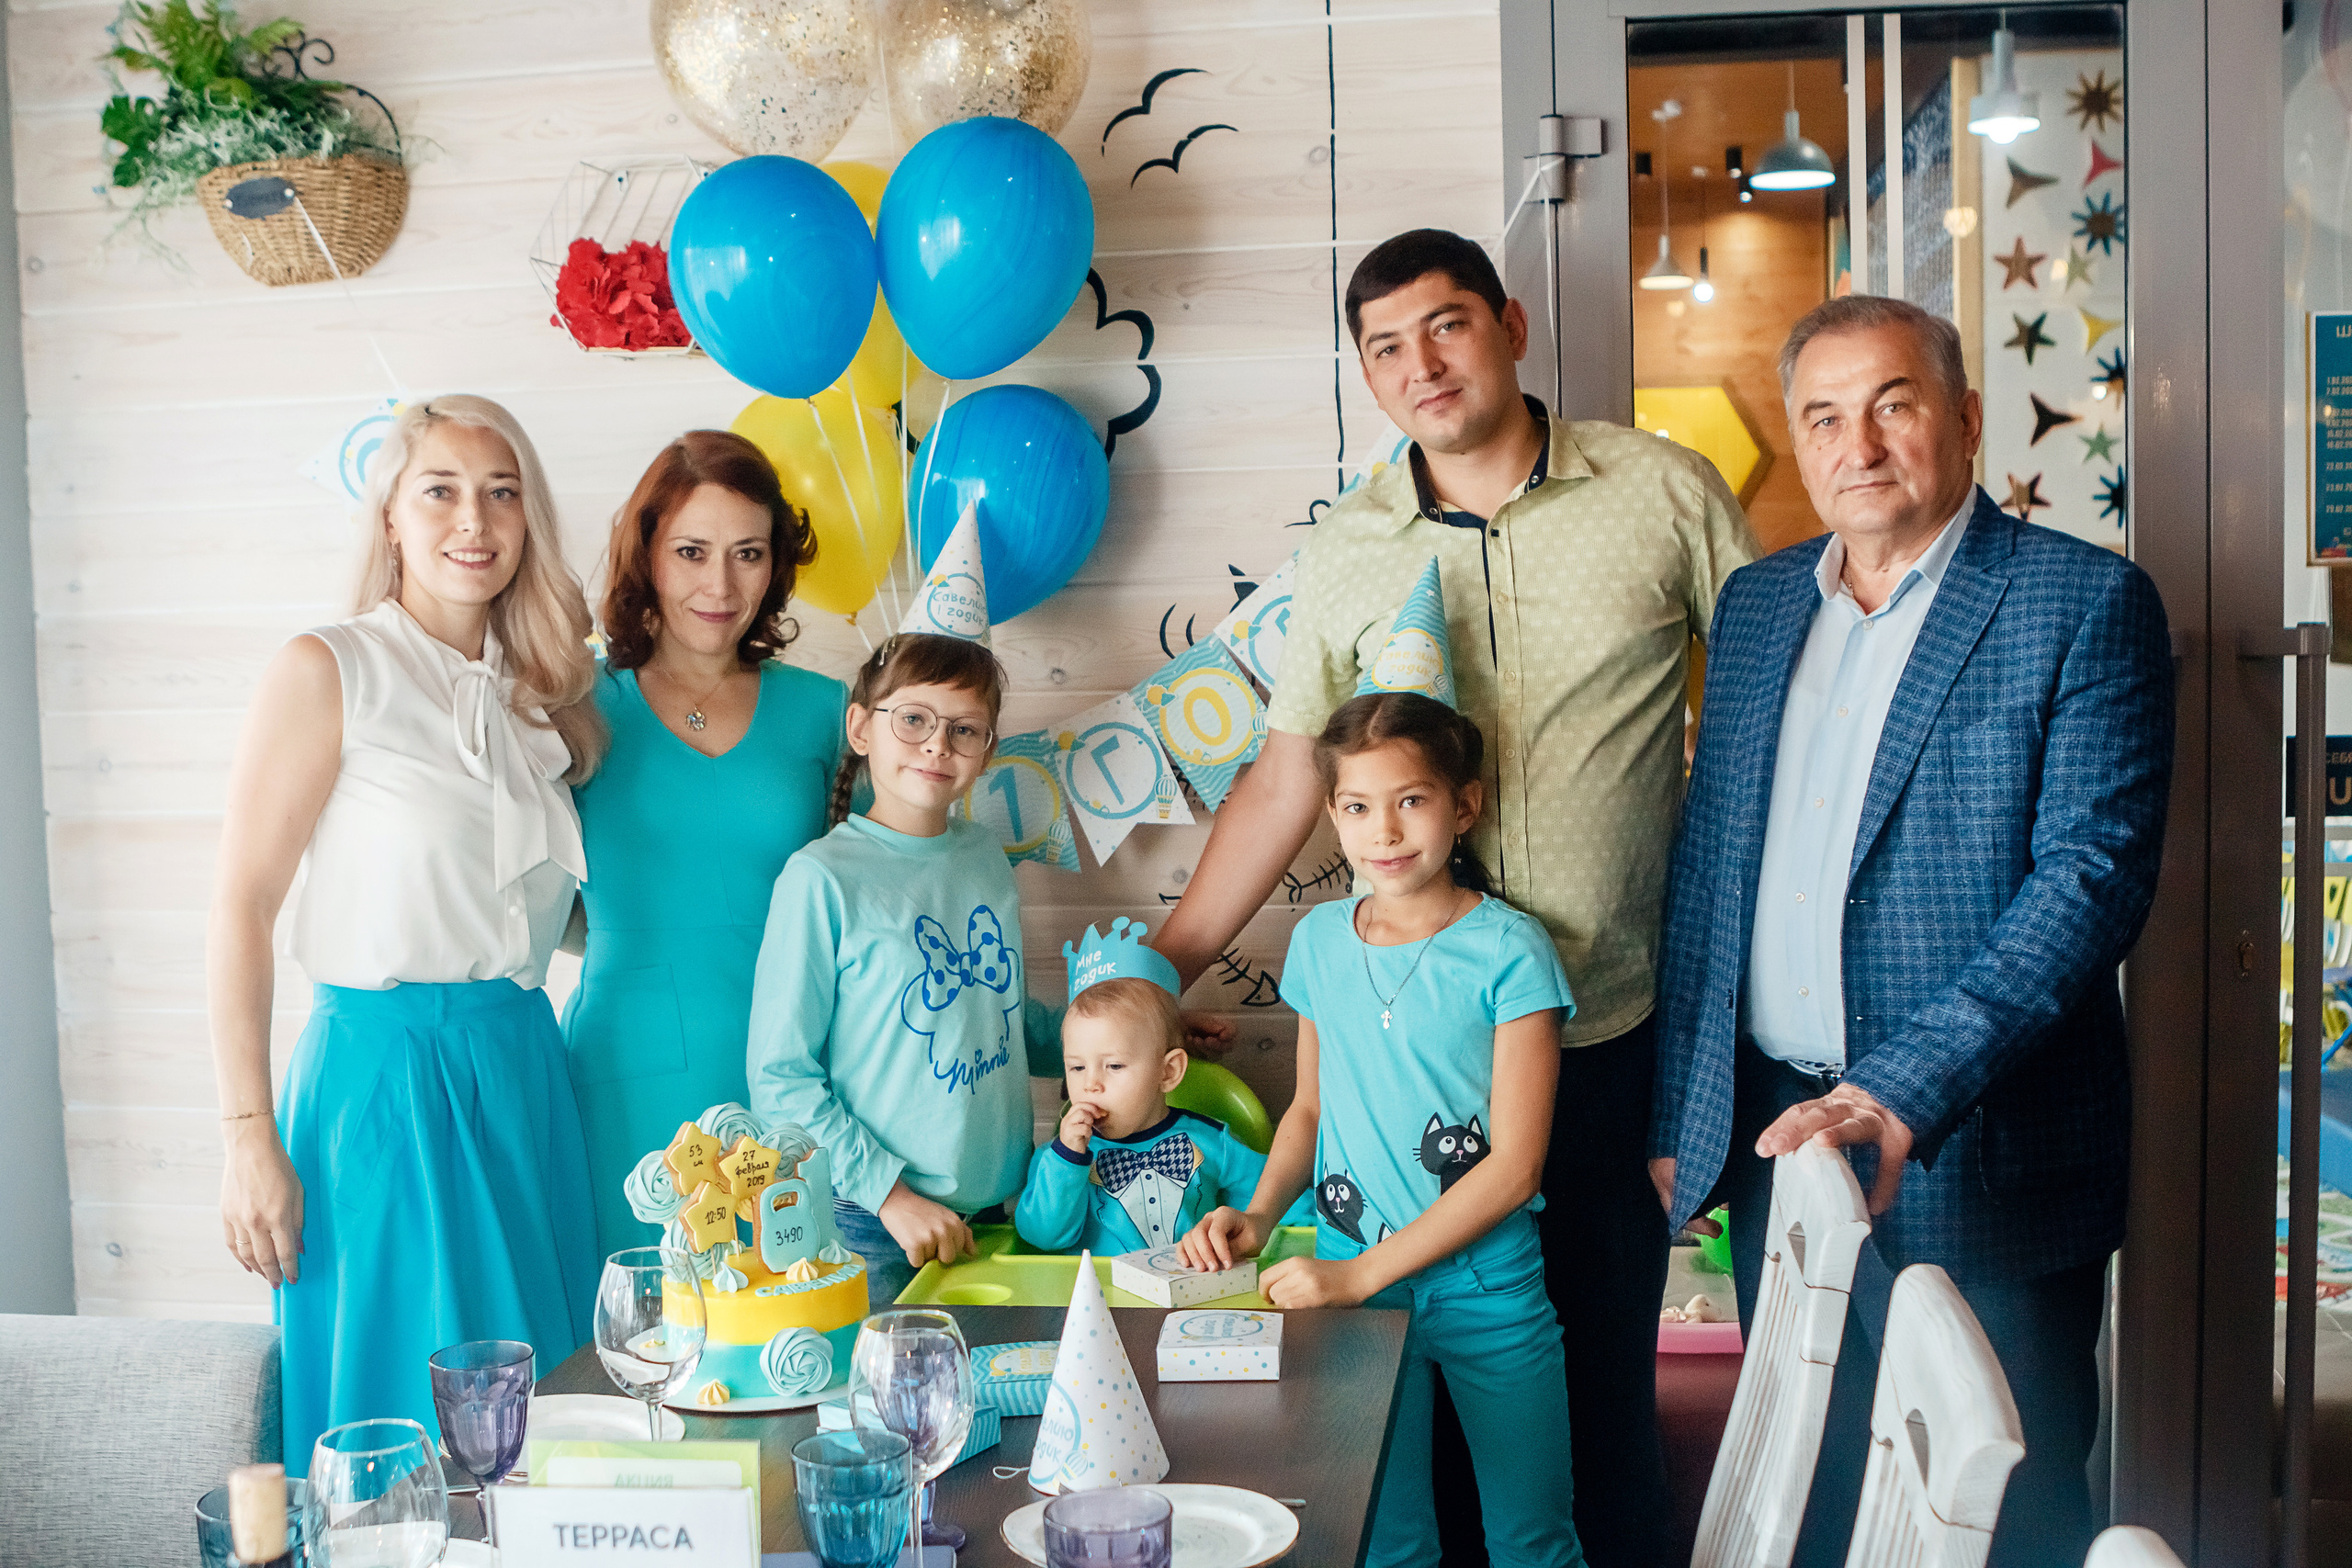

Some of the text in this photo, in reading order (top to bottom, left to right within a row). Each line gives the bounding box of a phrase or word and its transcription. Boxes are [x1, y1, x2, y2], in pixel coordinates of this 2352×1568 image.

[1073, 961, 1117, 993] годик
[933, 1035, 1010, 1096] Minnie
[689, 1144, 703, 1157] 53
[742, 1149, 756, 1162] 27
[735, 1161, 770, 1179] февраля
[746, 1174, 765, 1188] 2019
[705, 1206, 727, 1224] 12:50
[775, 1226, 803, 1247] 3490
[553, 1523, 695, 1550] ТЕРРАСА
